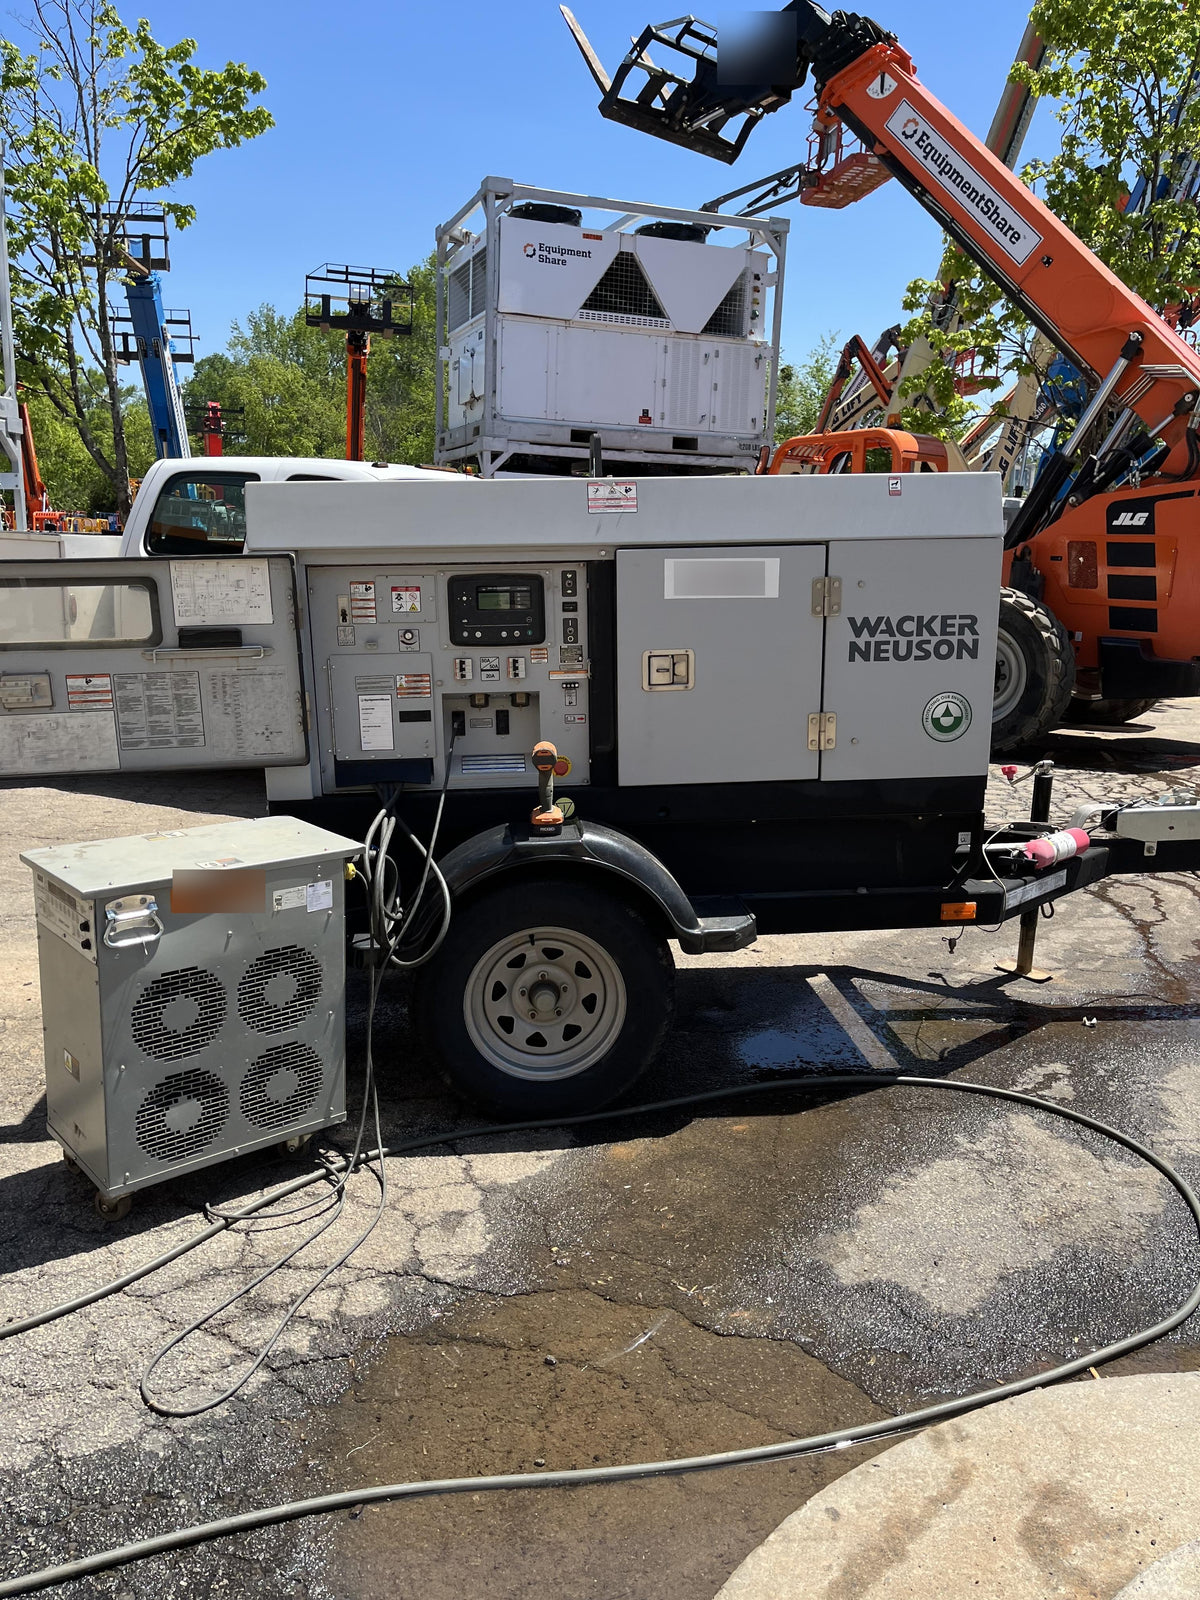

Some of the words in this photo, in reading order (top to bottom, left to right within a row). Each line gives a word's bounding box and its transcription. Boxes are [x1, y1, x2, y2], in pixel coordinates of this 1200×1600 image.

[914, 131, 1021, 245] EquipmentShare
[538, 242, 592, 259] Equipment
[538, 254, 567, 266] Share
[1111, 512, 1149, 526] JLG
[847, 614, 980, 638] WACKER
[848, 638, 980, 662] NEUSON
